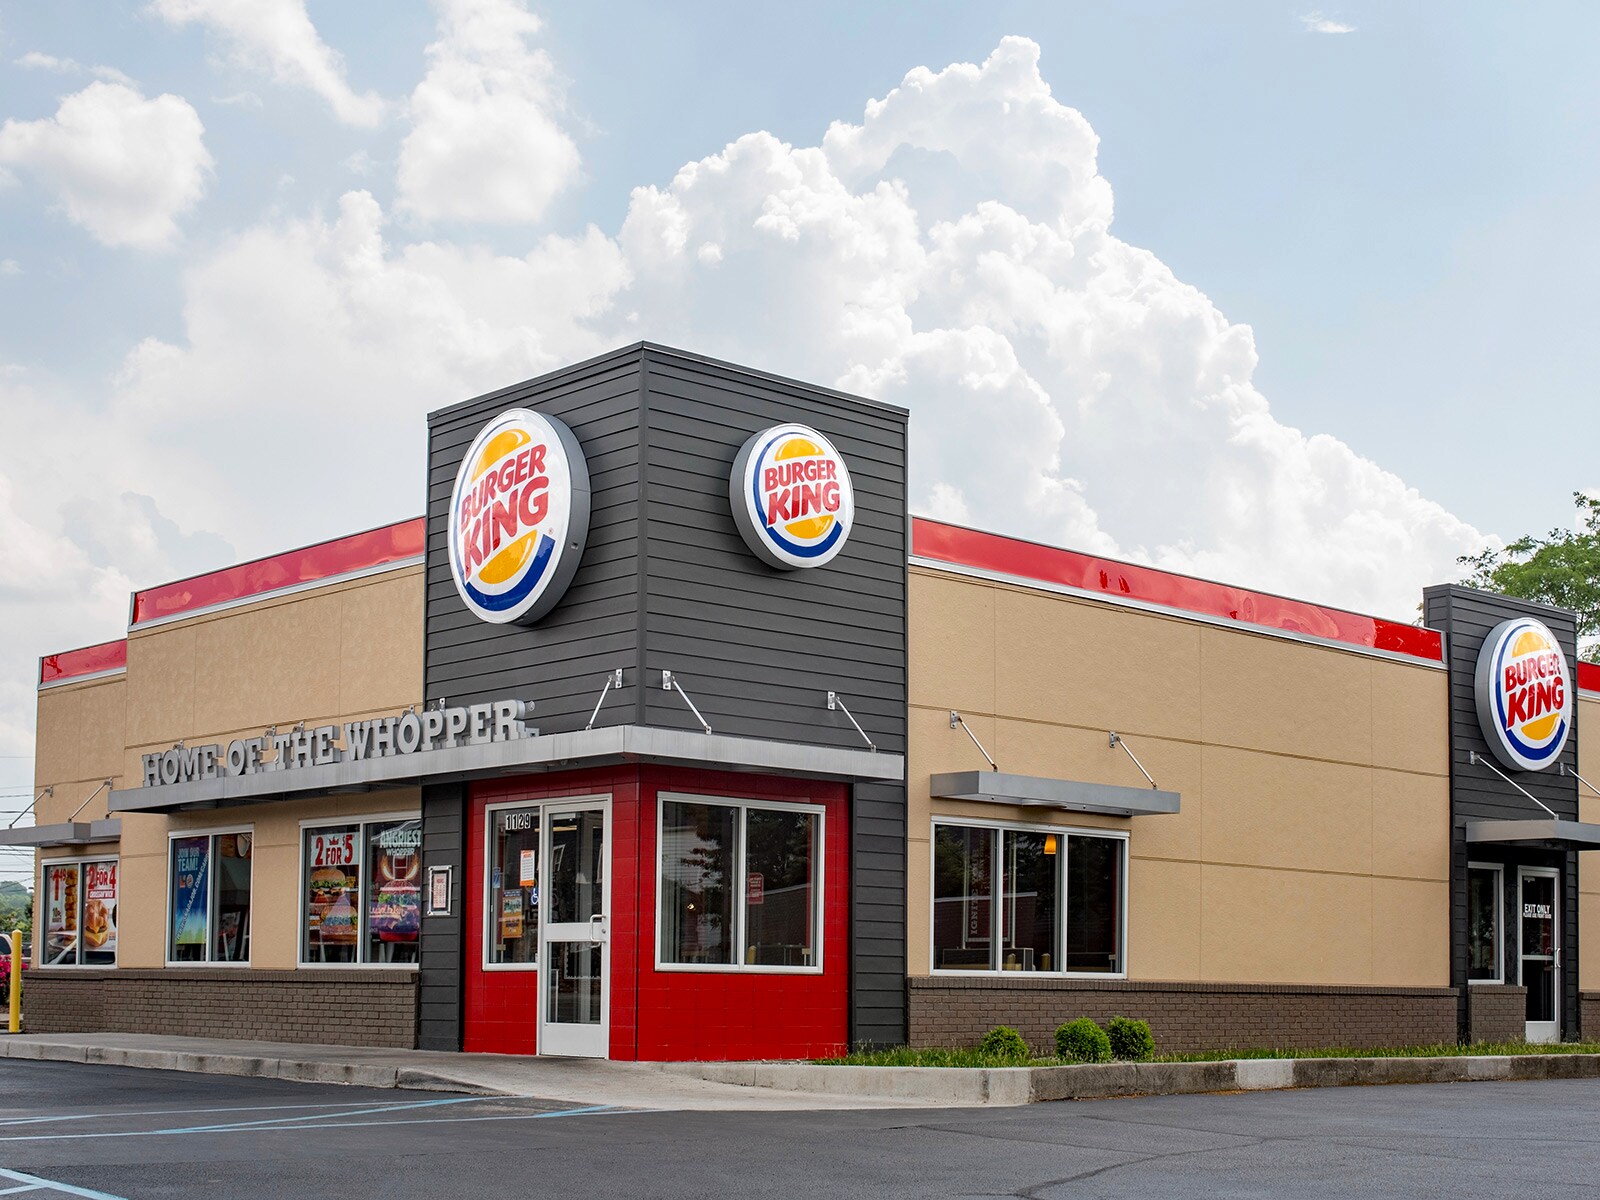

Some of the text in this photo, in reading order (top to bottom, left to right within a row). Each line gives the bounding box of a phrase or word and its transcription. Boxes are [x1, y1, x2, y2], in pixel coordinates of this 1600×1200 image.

[461, 444, 547, 535] BURGER
[765, 460, 836, 492] BURGER
[768, 481, 840, 525] KING
[464, 476, 549, 580] KING
[1505, 653, 1561, 693] BURGER
[1507, 676, 1564, 728] KING
[142, 700, 521, 787] HOME OF THE WHOPPER
[506, 813, 530, 830] 1129
[315, 836, 324, 866] 2
[326, 847, 342, 864] FOR
[380, 829, 421, 848] ANGRIEST
[96, 871, 108, 887] FOR
[178, 857, 199, 872] TEAM!
[1524, 903, 1550, 914] EXIT ONLY
